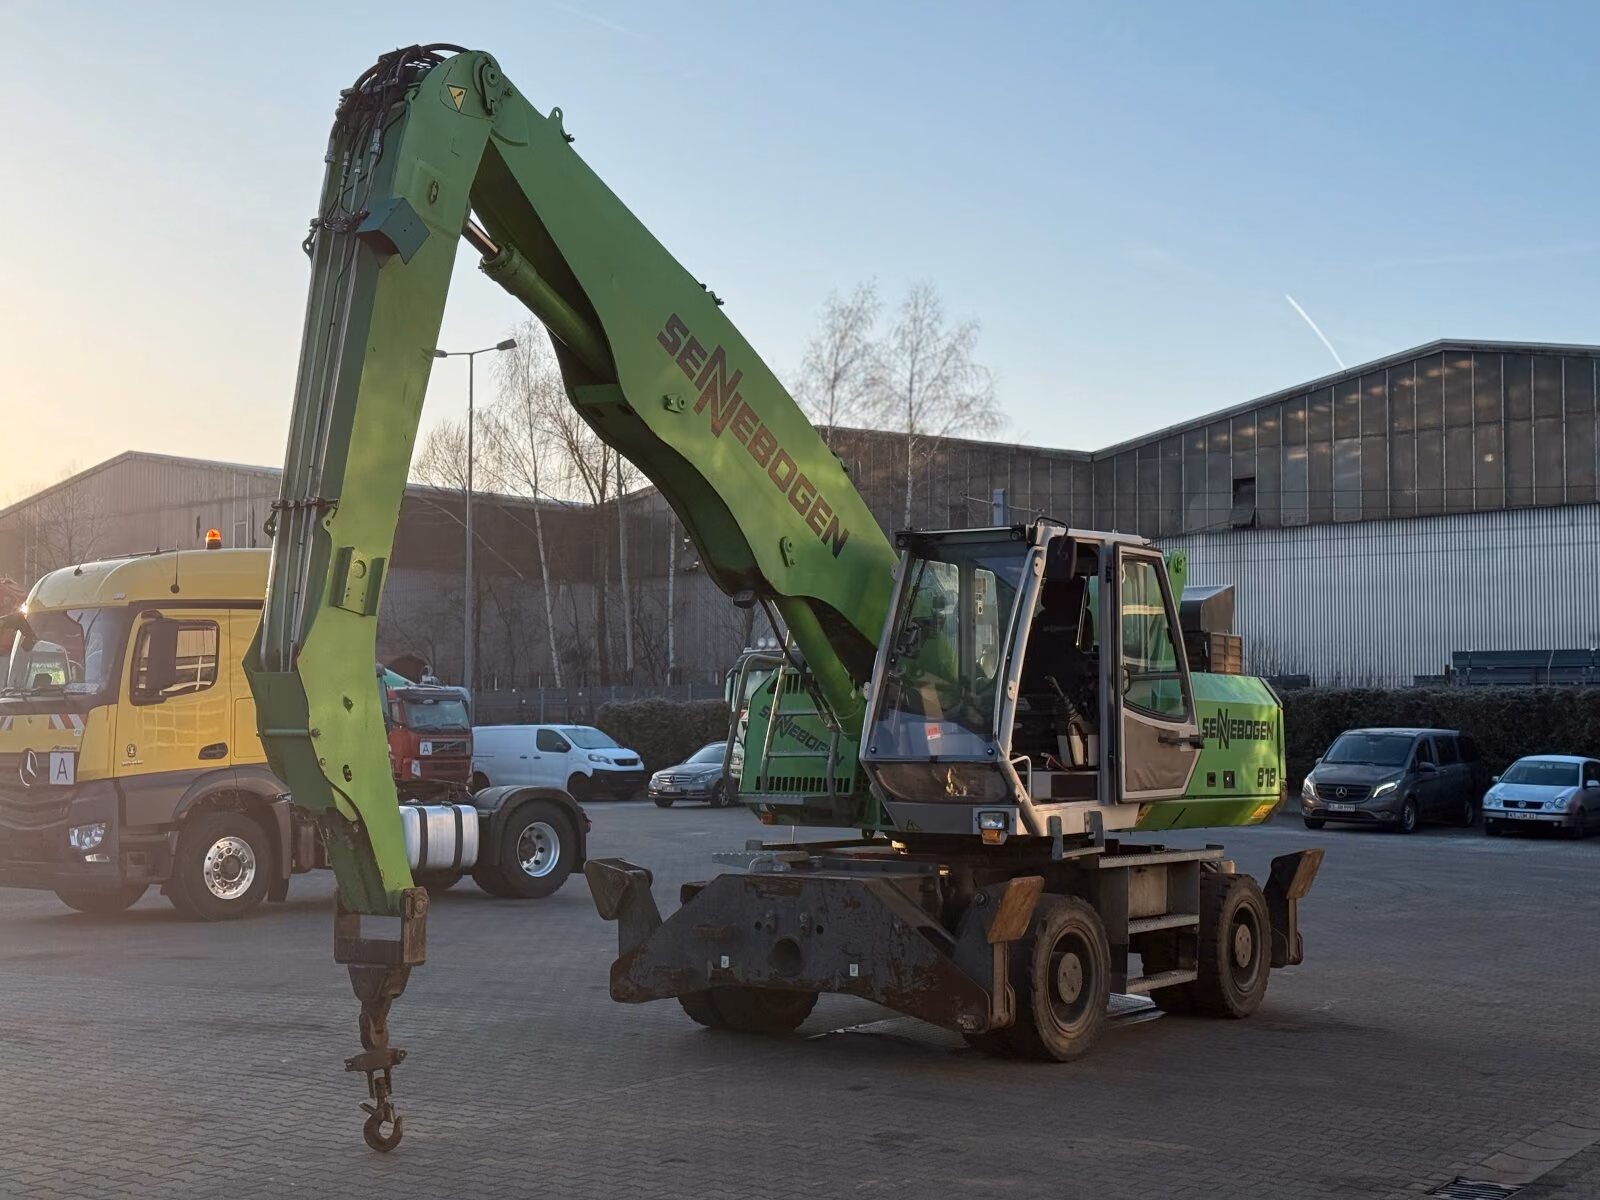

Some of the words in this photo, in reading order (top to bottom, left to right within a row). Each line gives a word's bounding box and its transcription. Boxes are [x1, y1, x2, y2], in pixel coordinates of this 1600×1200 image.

[656, 312, 850, 559] SENNEBOGEN
[1202, 708, 1274, 750] SENNEBOGEN
[422, 743, 430, 754] A
[56, 757, 68, 781] A
[1257, 768, 1276, 788] 818
